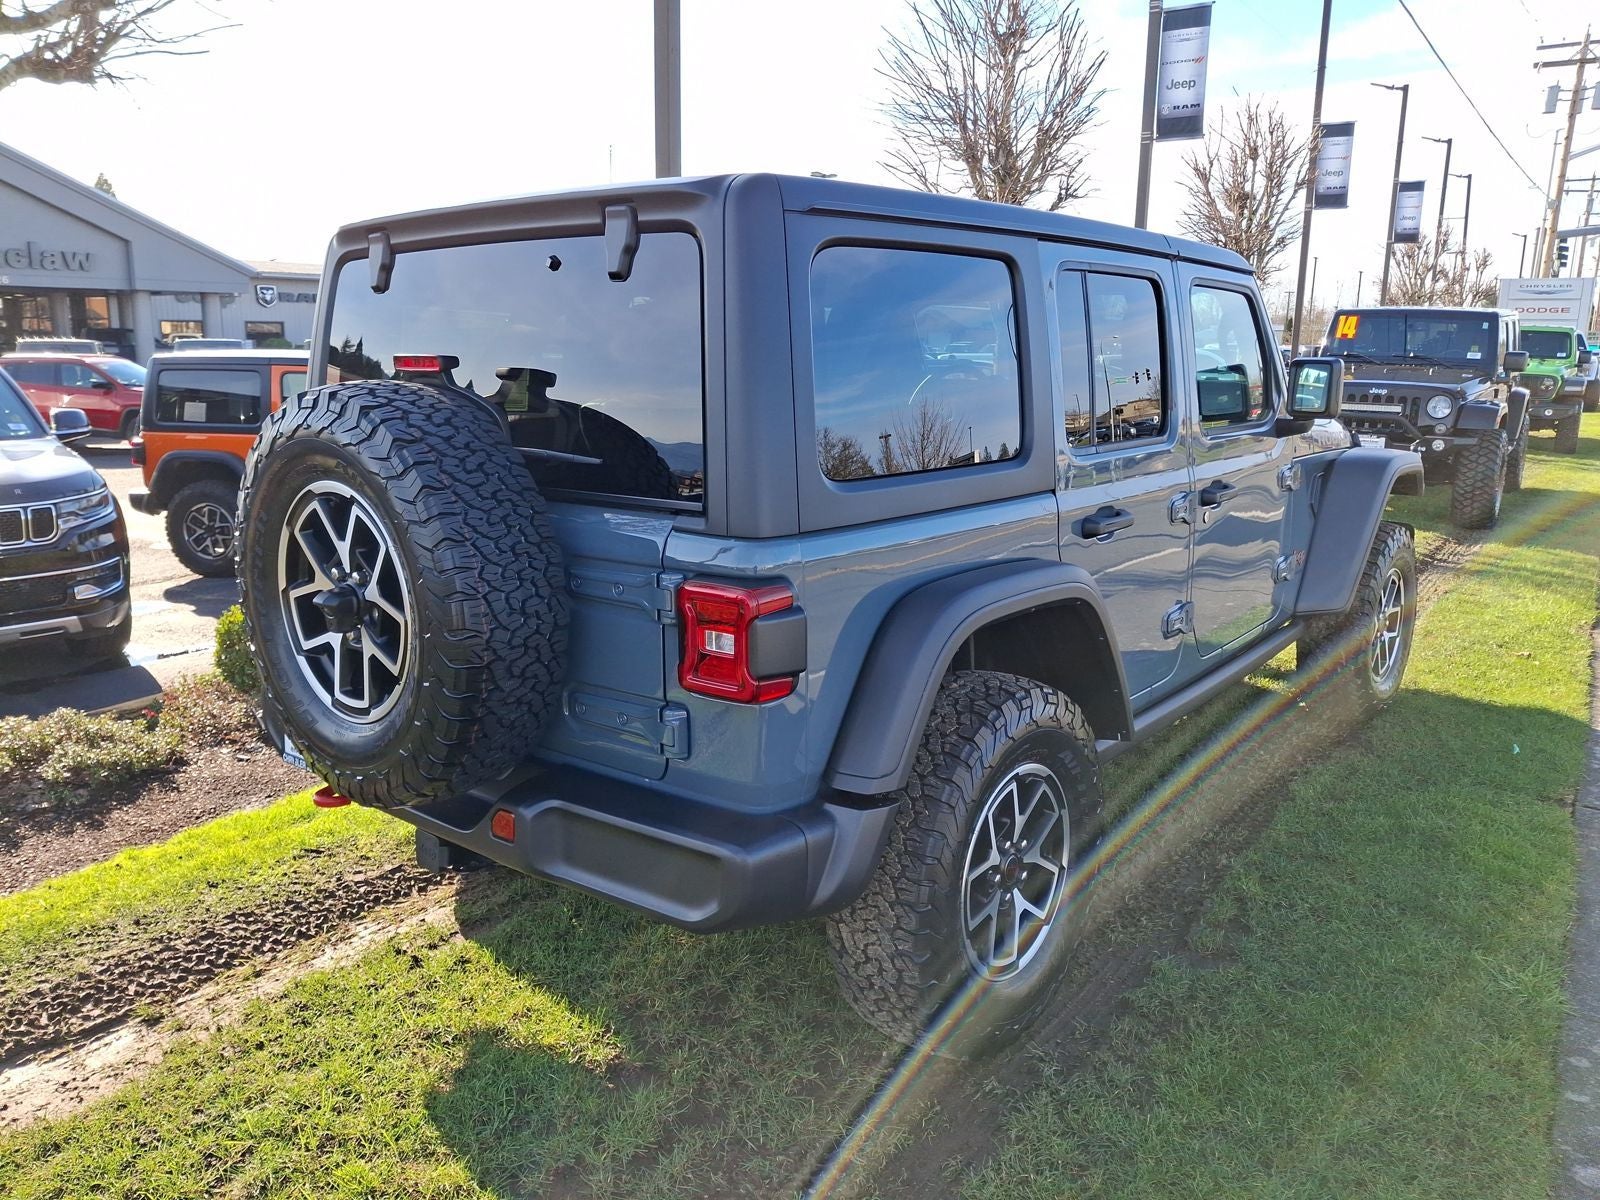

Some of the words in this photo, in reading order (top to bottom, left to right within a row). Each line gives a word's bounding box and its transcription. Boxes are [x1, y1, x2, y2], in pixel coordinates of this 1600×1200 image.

[1166, 79, 1196, 91] Jeep
[1172, 103, 1200, 111] RAM
[1321, 169, 1344, 178] Jeep
[0, 241, 95, 272] claw
[1335, 315, 1358, 339] 14
[1369, 387, 1388, 395] Jeep
